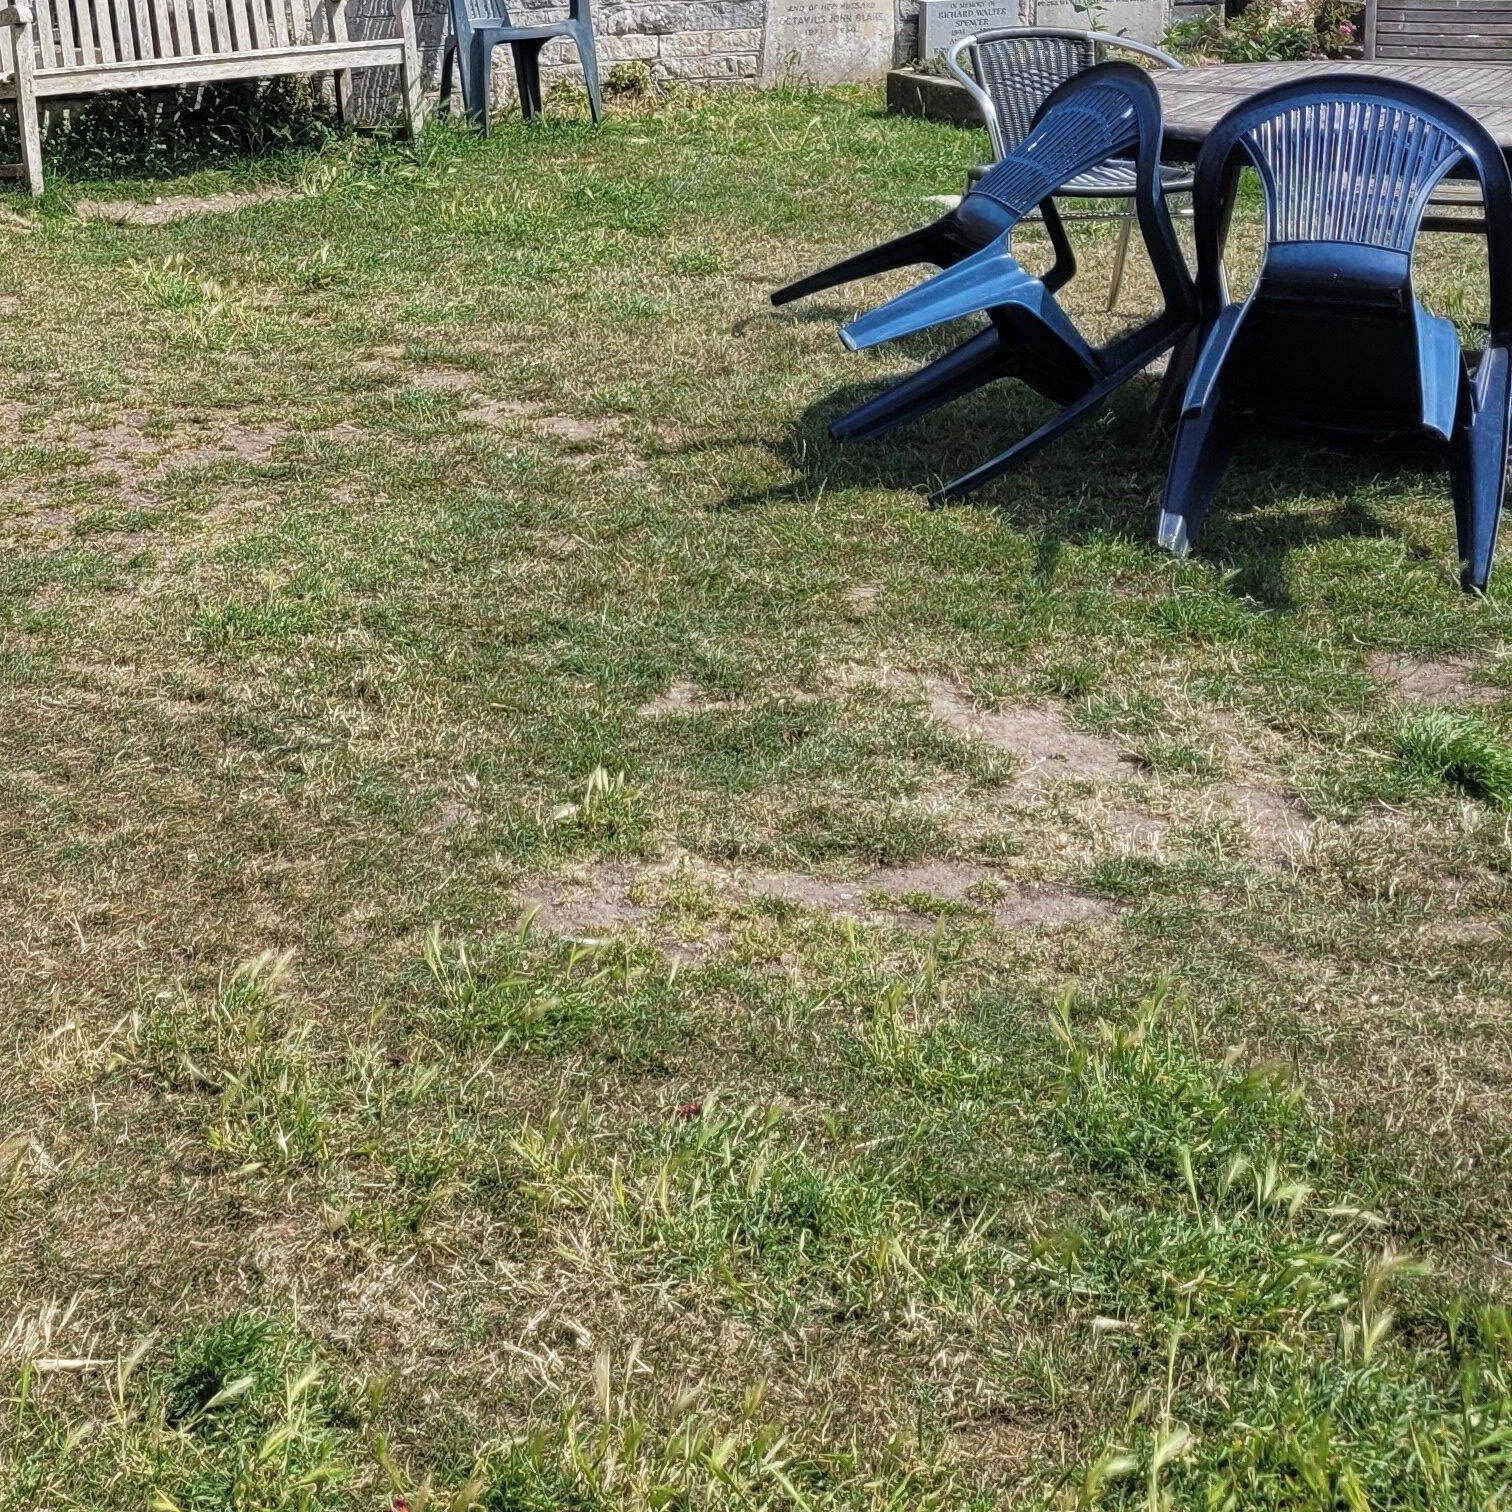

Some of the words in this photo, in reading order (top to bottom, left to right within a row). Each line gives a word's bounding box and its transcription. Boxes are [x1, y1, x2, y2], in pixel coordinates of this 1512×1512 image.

[829, 13, 852, 23] JOHN
[855, 13, 884, 22] BLAKE
[938, 10, 973, 19] RICHARD
[976, 8, 1007, 16] WALTER
[955, 19, 989, 27] SPENCER
